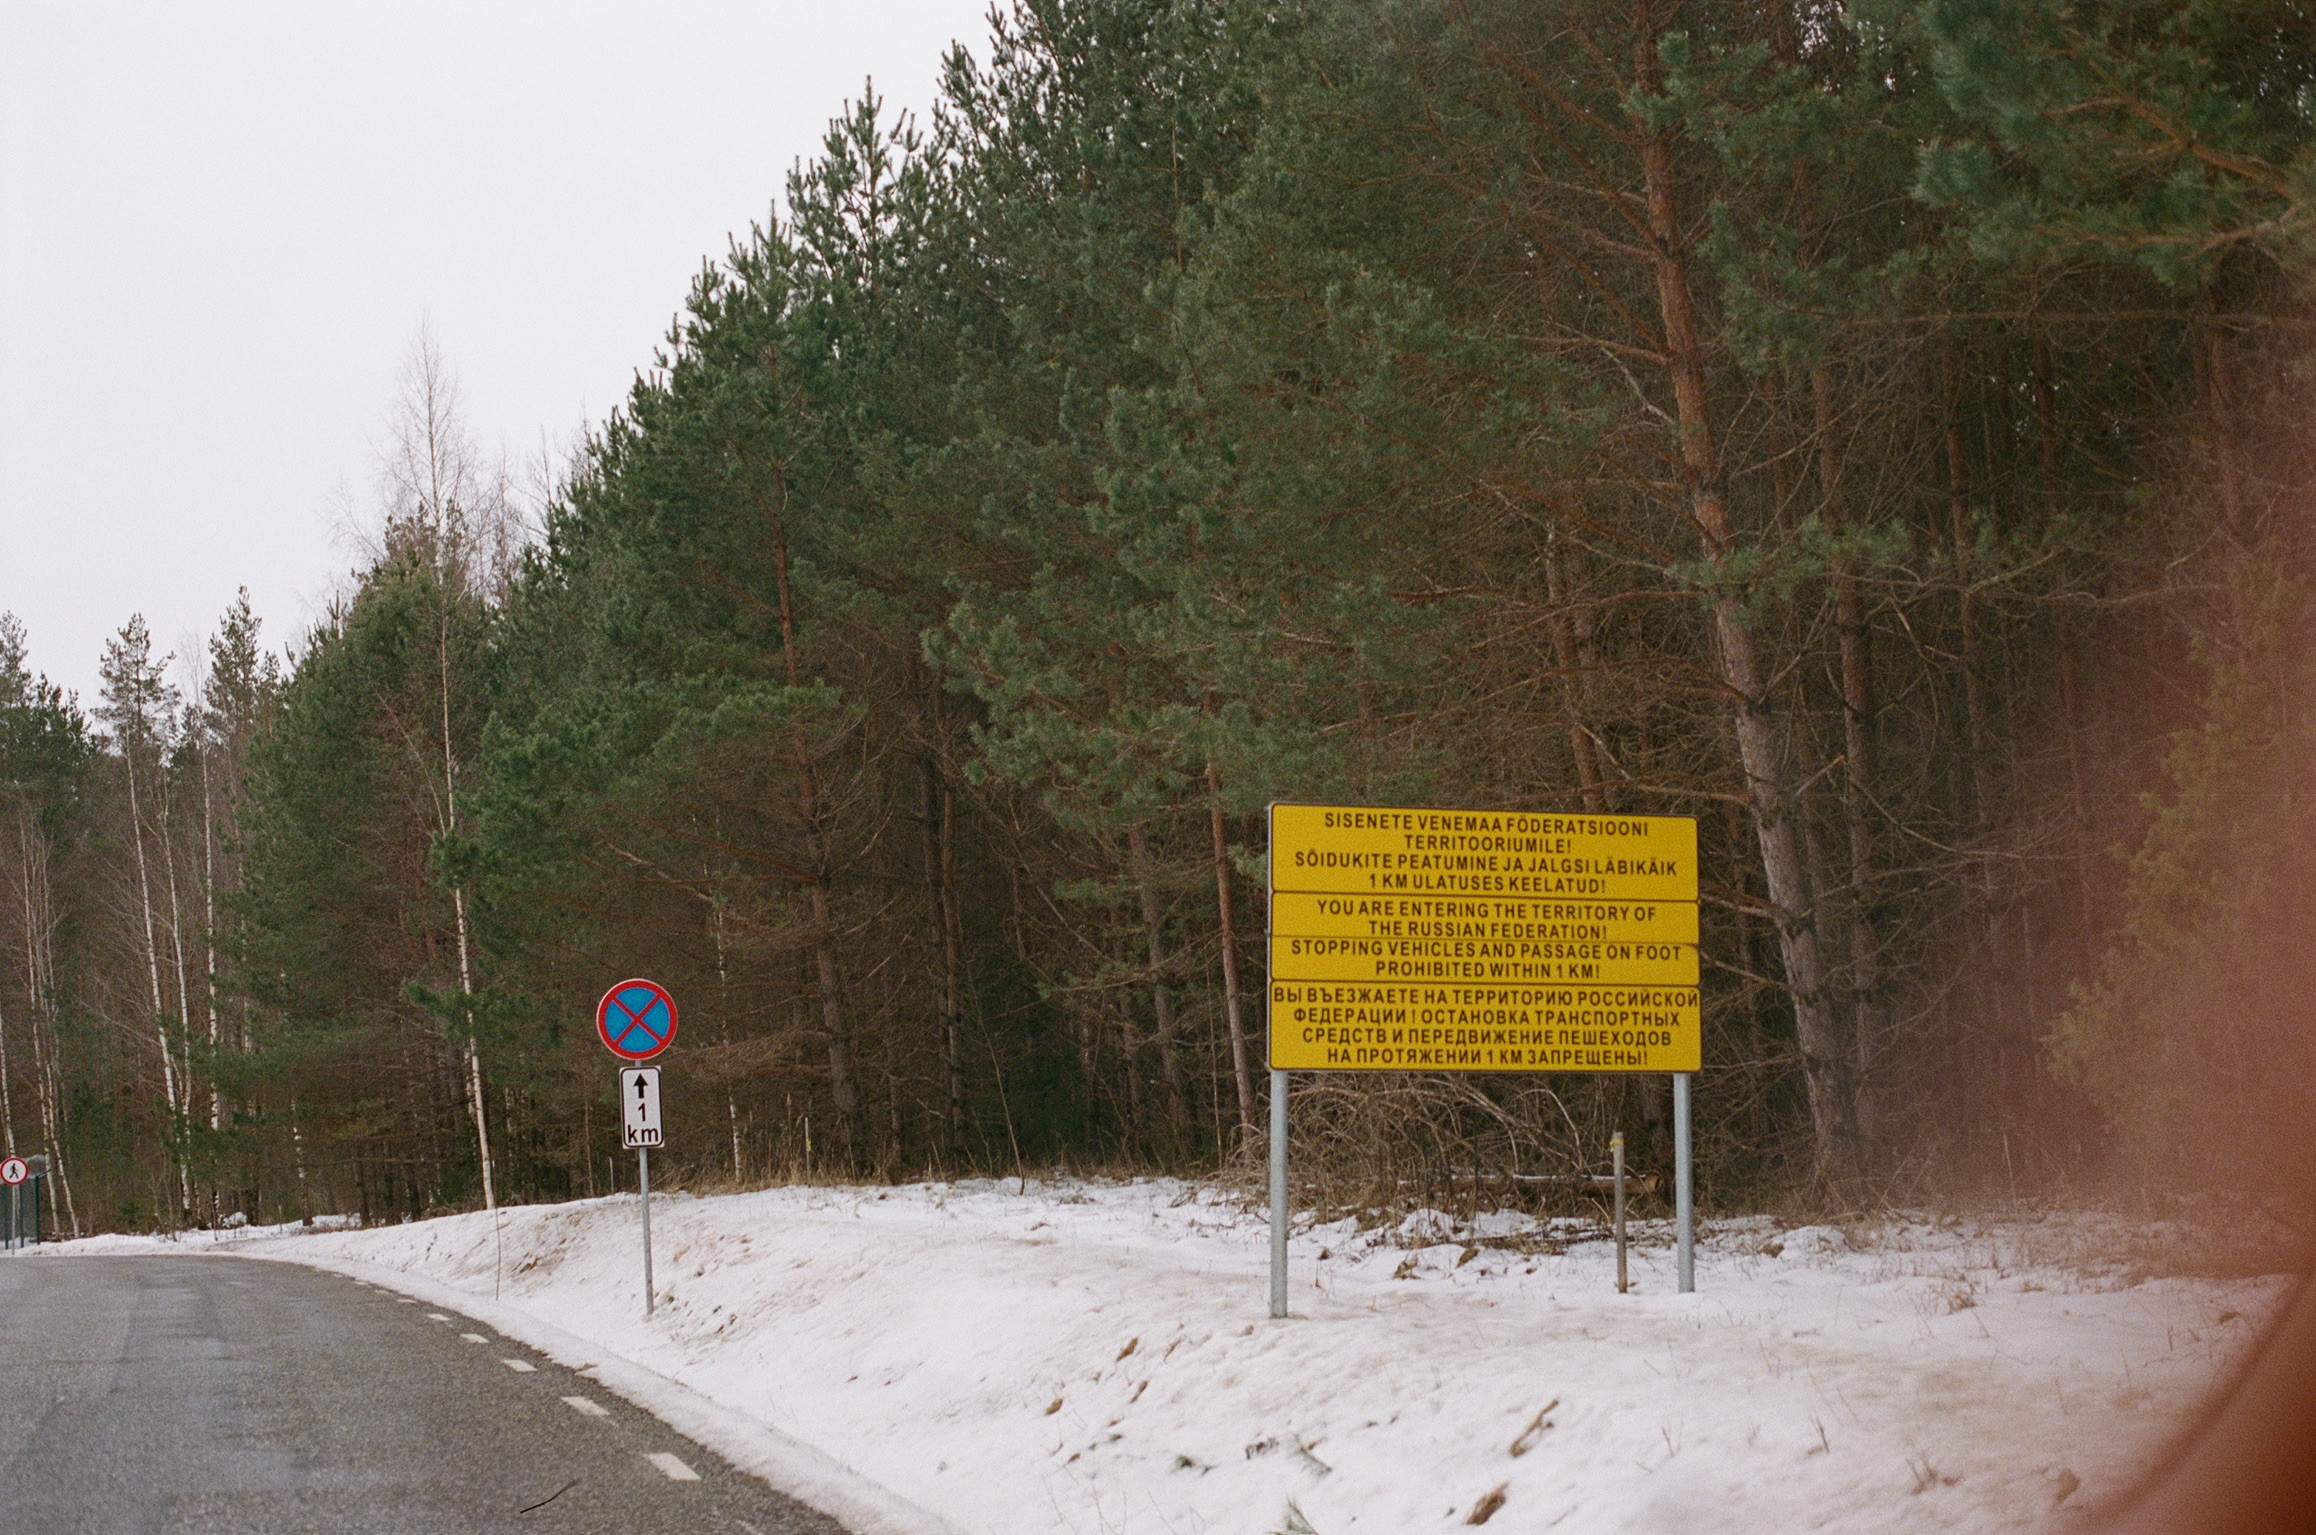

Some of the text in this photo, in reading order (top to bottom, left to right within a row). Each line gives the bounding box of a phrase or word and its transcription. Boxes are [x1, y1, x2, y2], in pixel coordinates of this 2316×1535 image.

[1324, 812, 1648, 836] SISENETE VENEMAA FÖDERATSIOONI
[1404, 835, 1571, 853] TERRITOORIUMILE!
[1398, 854, 1498, 871] PEATUMINE
[1503, 857, 1523, 871] JA
[1528, 858, 1589, 873] JALGSI
[1595, 856, 1677, 876] LÄBIKÄIK
[1370, 874, 1605, 893] 1 KM ULATUSES KEELATUD!
[1318, 900, 1656, 921] YOU ARE ENTERING THE TERRITORY OF
[1369, 921, 1607, 939] THE RUSSIAN FEDERATION!
[1292, 939, 1681, 960] STOPPING VEHICLES AND PASSAGE ON FOOT
[1376, 961, 1599, 978] PROHIBITED WITHIN 1 KM!
[1274, 987, 1698, 1007] ВЫ ВЪЕЗЖАЕТЕ НА ТЕРРИТОРИЮ РОССИЙСКОЙ
[1421, 1009, 1530, 1025] ОСТАНОВКА
[1534, 1010, 1680, 1026] ТРАНСПОРТНЫХ
[1302, 1028, 1671, 1047] СРЕДСТВ И ПЕРЕДВИЖЕНИЕ ПЕШЕХОДОВ
[1328, 1048, 1648, 1066] НА ПРОТЯЖЕНИИ 1 КМ ЗАПРЕЩЕНЫ!
[638, 1103, 646, 1122] 1
[627, 1124, 659, 1143] km
